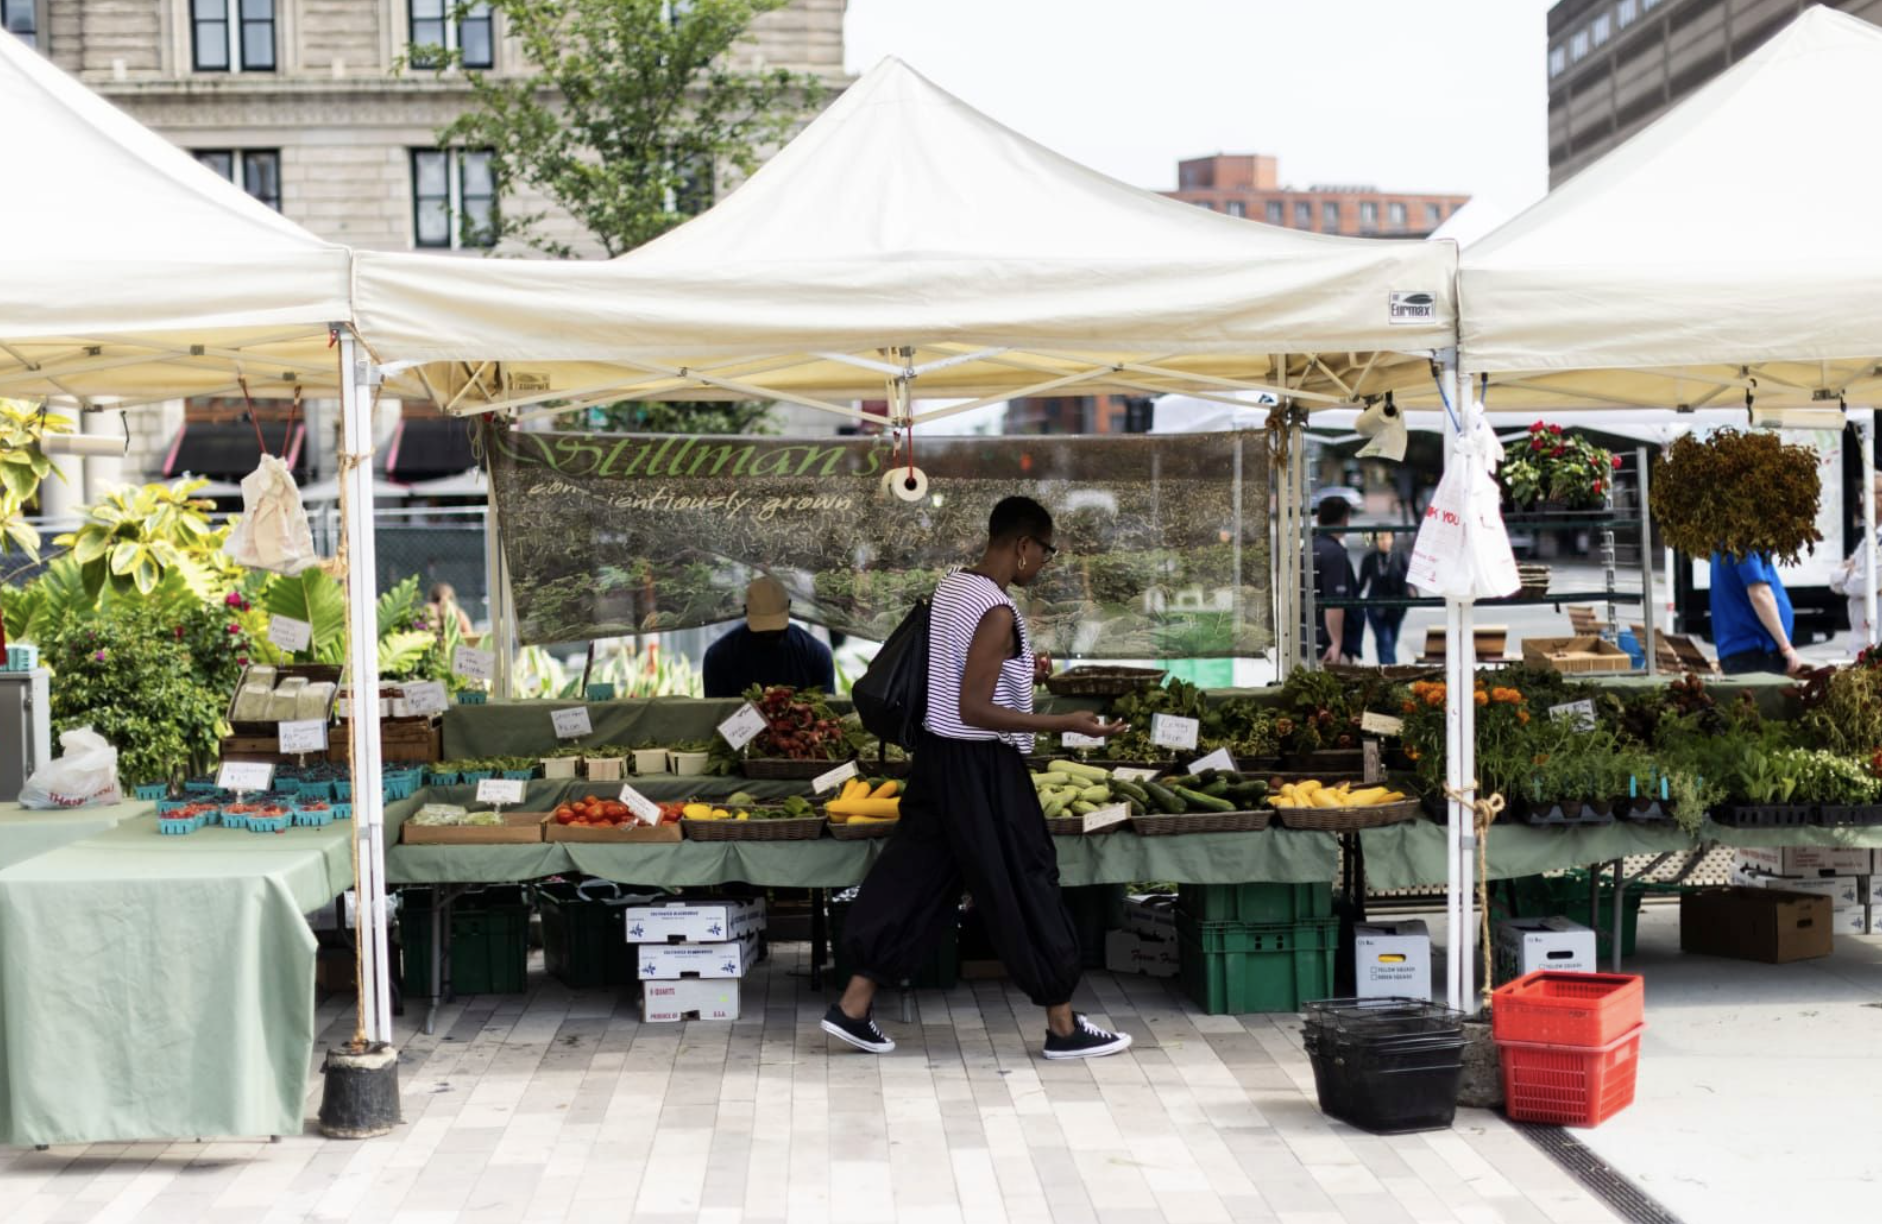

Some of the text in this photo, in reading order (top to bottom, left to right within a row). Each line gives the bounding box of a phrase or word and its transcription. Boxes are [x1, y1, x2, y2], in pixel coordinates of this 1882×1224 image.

[1391, 303, 1430, 317] Eurmax
[497, 433, 891, 477] Stillmans
[527, 478, 854, 521] conientiously grown
[1442, 510, 1461, 527] YOU
